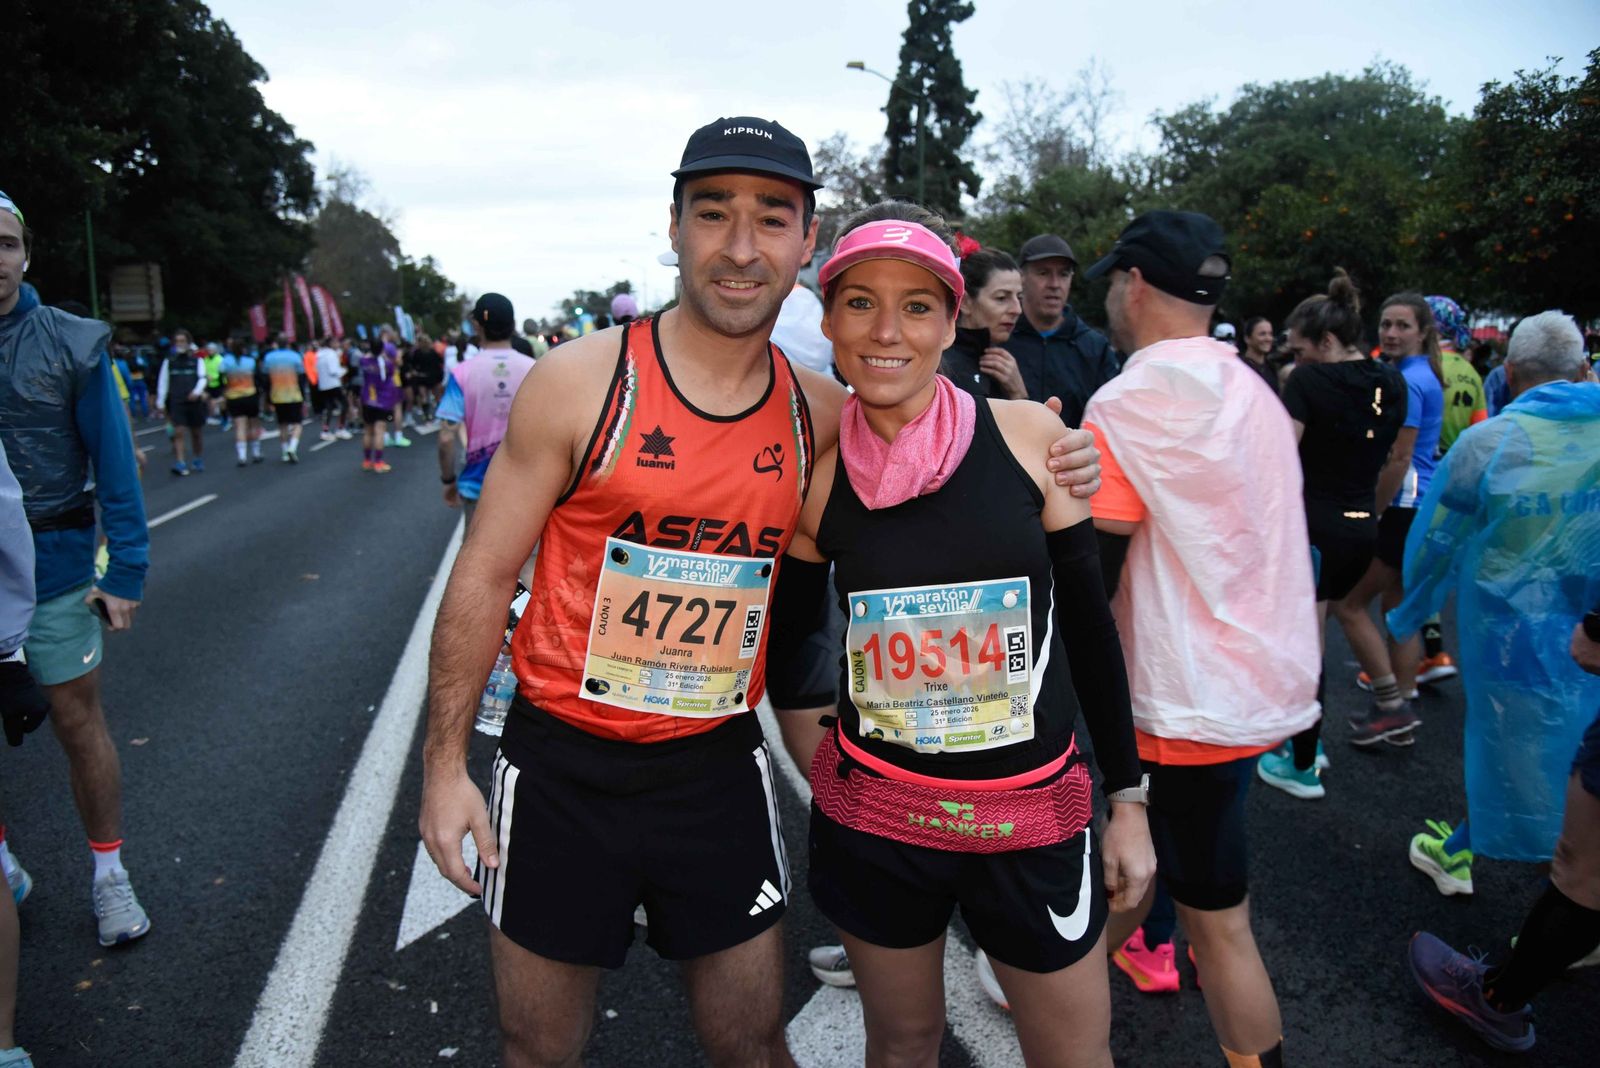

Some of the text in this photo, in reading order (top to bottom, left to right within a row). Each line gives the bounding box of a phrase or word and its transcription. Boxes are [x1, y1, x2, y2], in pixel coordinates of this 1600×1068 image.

[723, 126, 773, 140] KIPRUN
[636, 457, 675, 470] luanvi
[610, 511, 785, 558] ASFAS
[667, 556, 729, 573] maratón
[680, 570, 728, 583] sevilla
[903, 588, 968, 605] maratón
[919, 598, 969, 614] sevilla
[598, 597, 611, 636] CAJÓN 3
[621, 589, 737, 646] 4727
[659, 645, 693, 658] Juanra
[863, 622, 1006, 682] 19514
[610, 651, 633, 663] Juan
[635, 656, 667, 669] Ramón
[669, 661, 698, 672] Rivera
[700, 664, 733, 673] Rubiales
[853, 650, 865, 693] CAJÓN 4
[924, 682, 948, 692] Trixe
[643, 694, 670, 706] HOKA
[676, 699, 708, 709] Sprinter
[892, 699, 924, 709] Beatriz
[926, 696, 974, 706] Castellano
[940, 708, 961, 716] enero
[962, 705, 979, 713] 2026
[915, 735, 942, 745] HOKA
[948, 733, 982, 743] Sprinter
[907, 812, 1015, 839] HANKER
